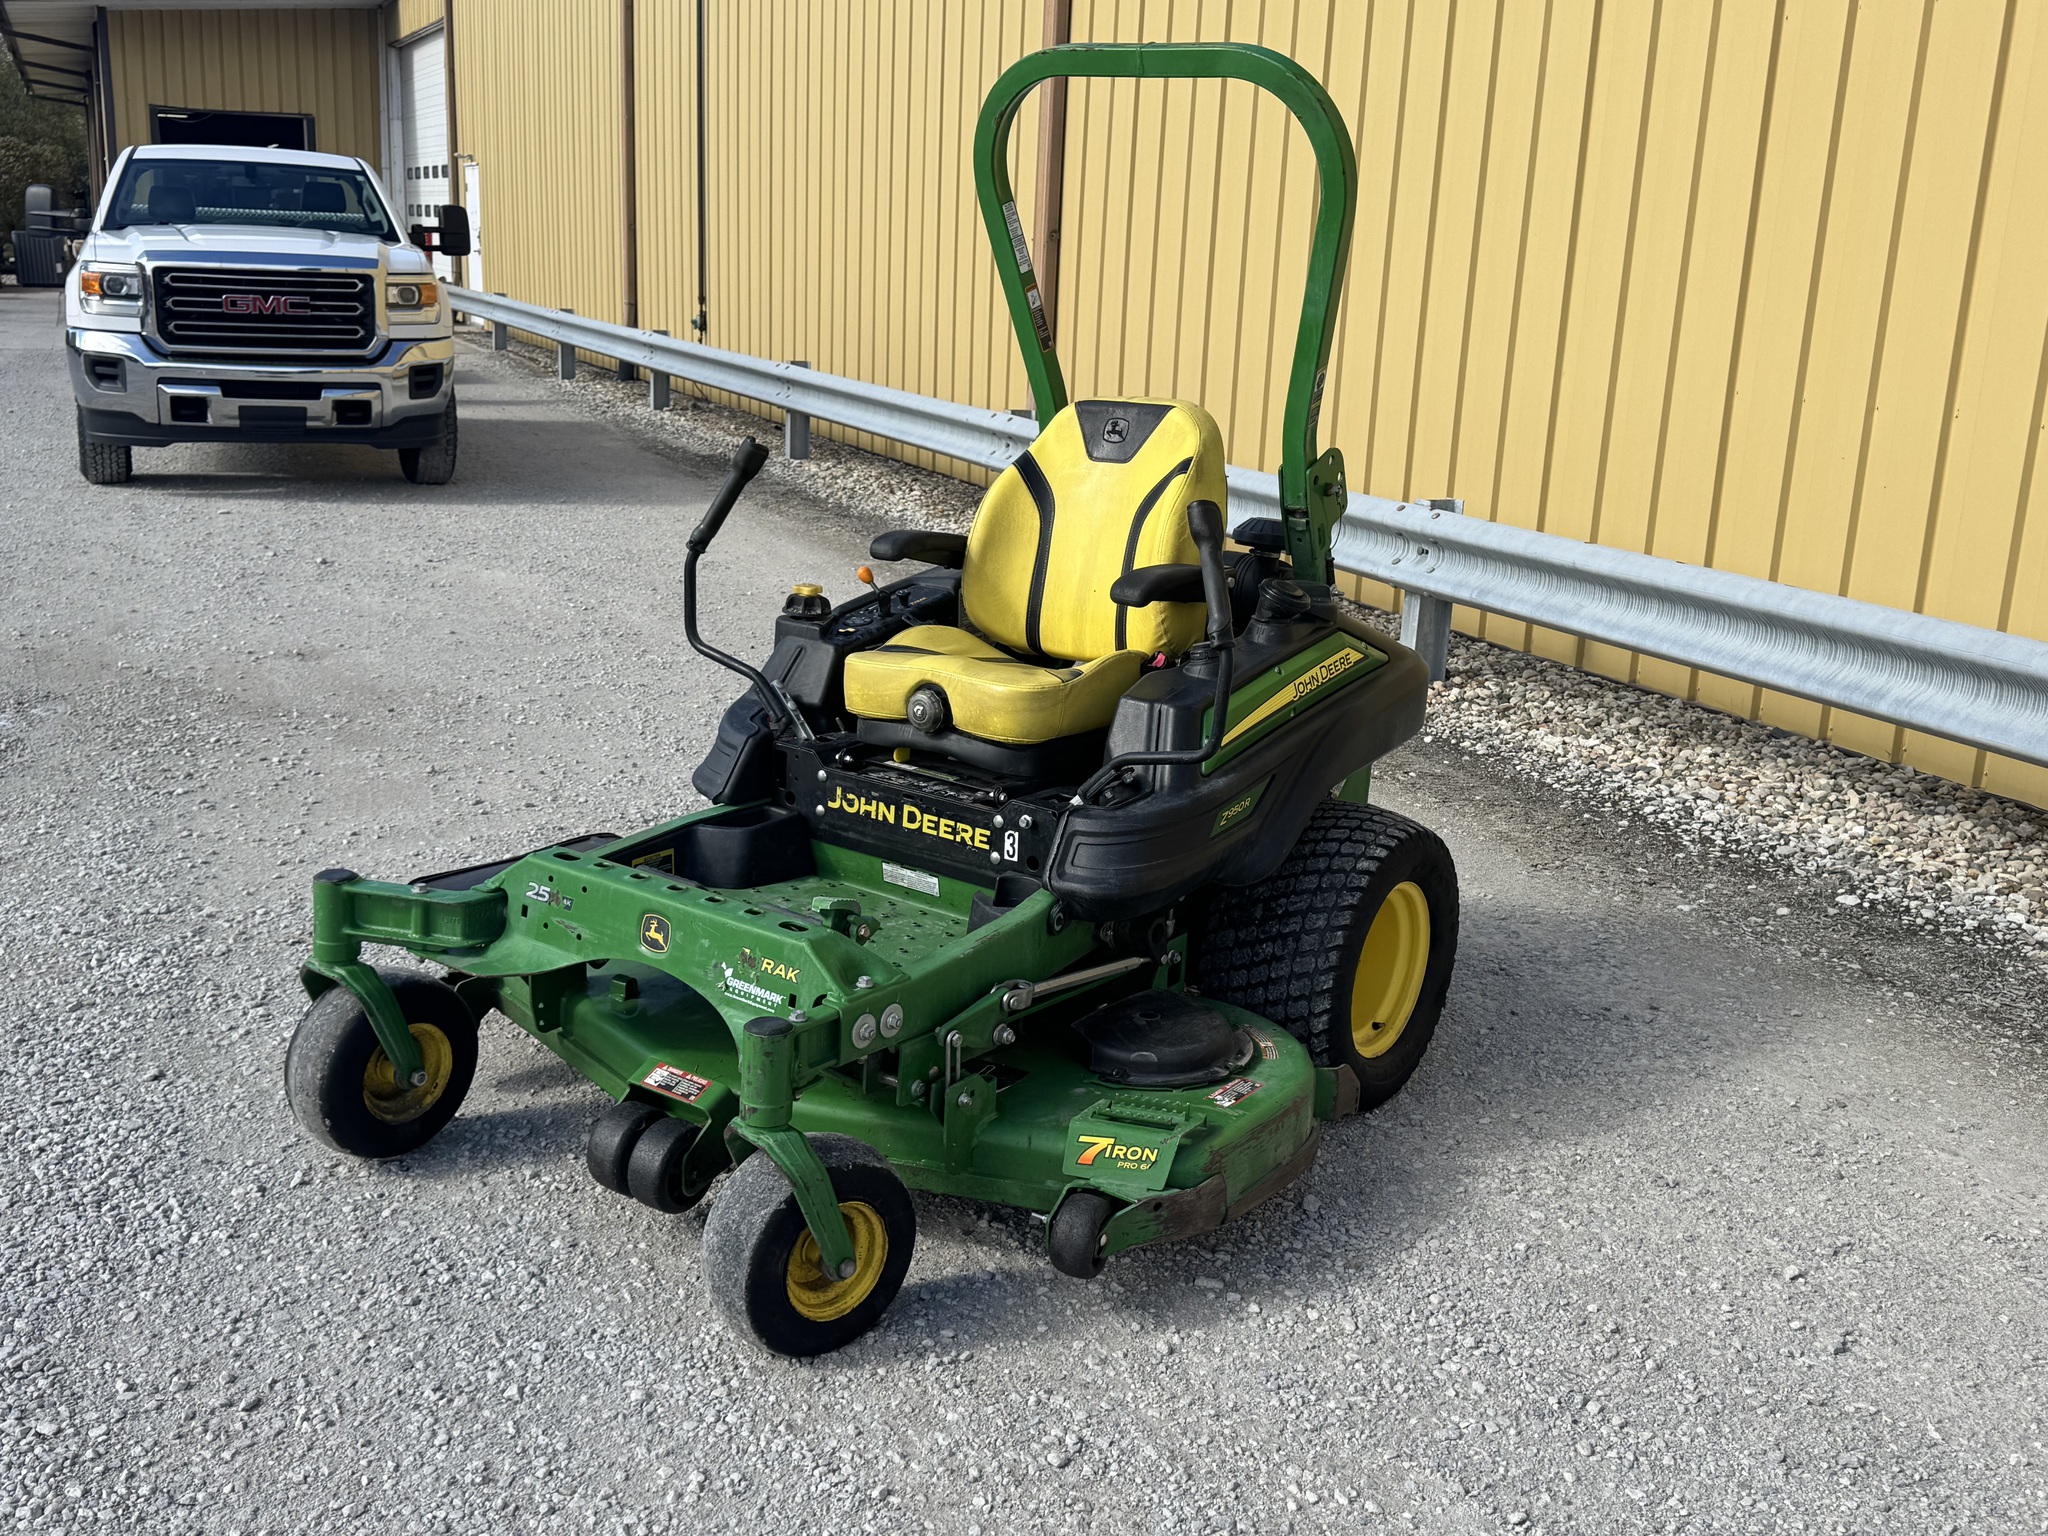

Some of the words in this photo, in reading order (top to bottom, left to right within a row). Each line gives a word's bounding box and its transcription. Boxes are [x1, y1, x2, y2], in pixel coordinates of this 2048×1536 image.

[222, 294, 311, 315] GMC
[1292, 671, 1320, 699] JOHN
[1319, 652, 1353, 680] DEERE
[827, 786, 896, 825] JOHN
[902, 803, 992, 850] DEERE
[1219, 797, 1251, 826] Z950R
[1005, 832, 1017, 859] 3
[726, 977, 783, 1005] GREENMARK
[1116, 1161, 1139, 1170] PRO
